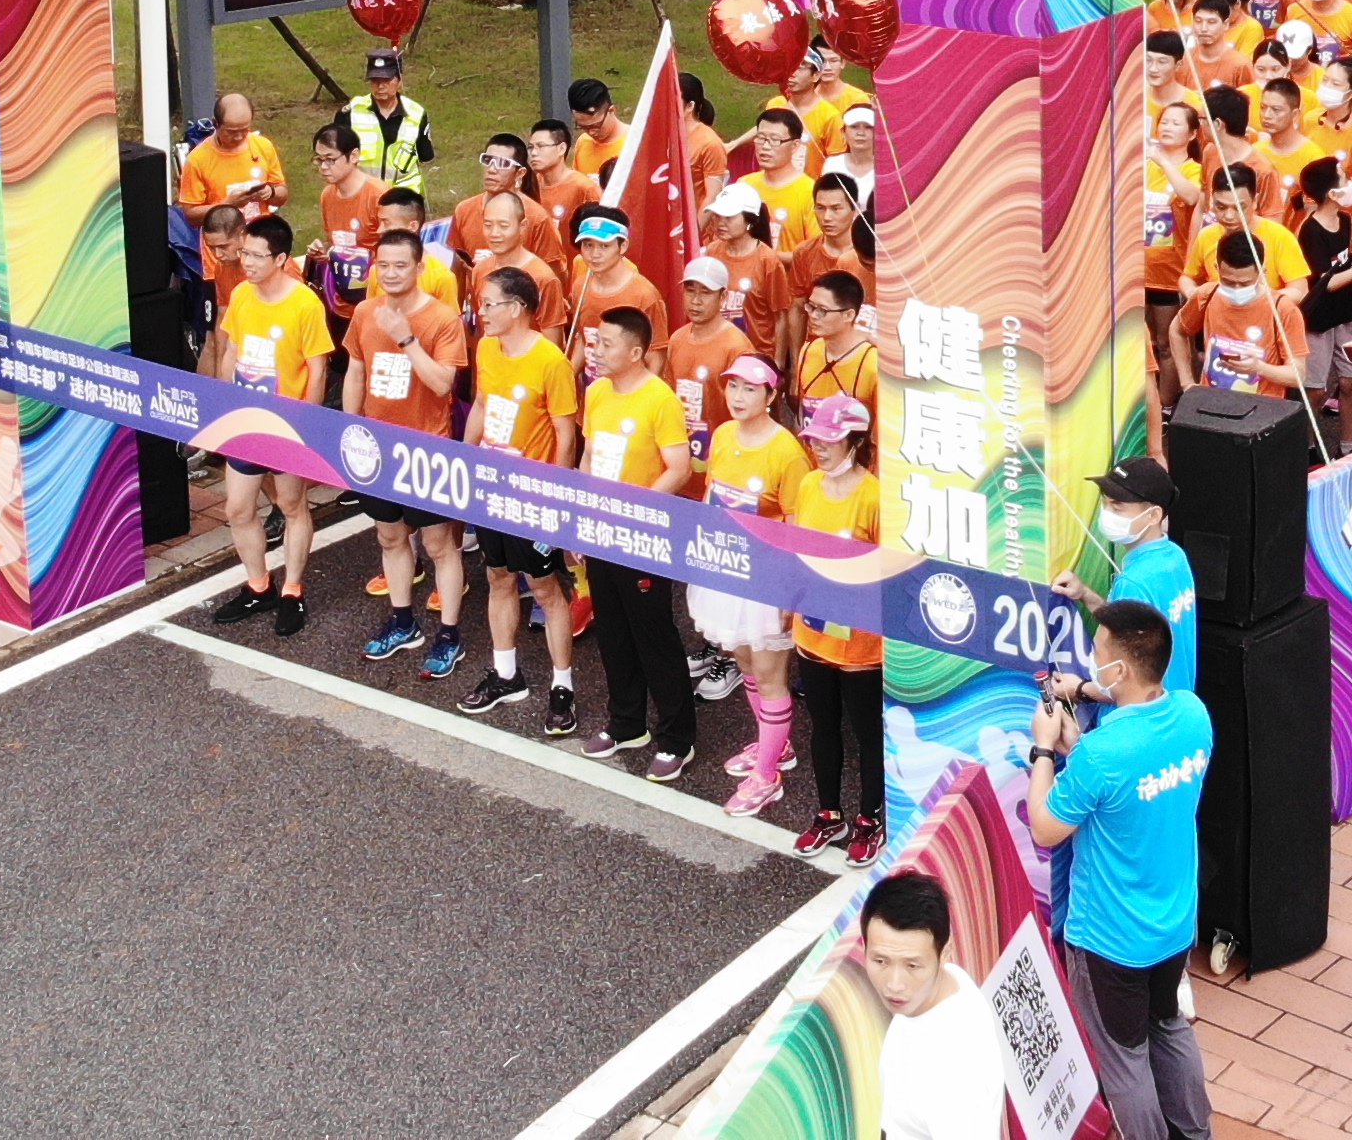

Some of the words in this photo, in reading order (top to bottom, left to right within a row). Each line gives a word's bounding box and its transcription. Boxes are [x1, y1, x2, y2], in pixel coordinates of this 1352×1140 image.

[1000, 315, 1021, 418] Cheering
[69, 374, 143, 417] 迷你马拉松
[392, 442, 470, 510] 2020
[1003, 455, 1019, 492] the
[576, 515, 673, 565] 迷你马拉松
[684, 524, 751, 574] ALWAYS
[684, 556, 721, 575] OUTDOOR
[1036, 1057, 1078, 1131] 二维码扫一扫
